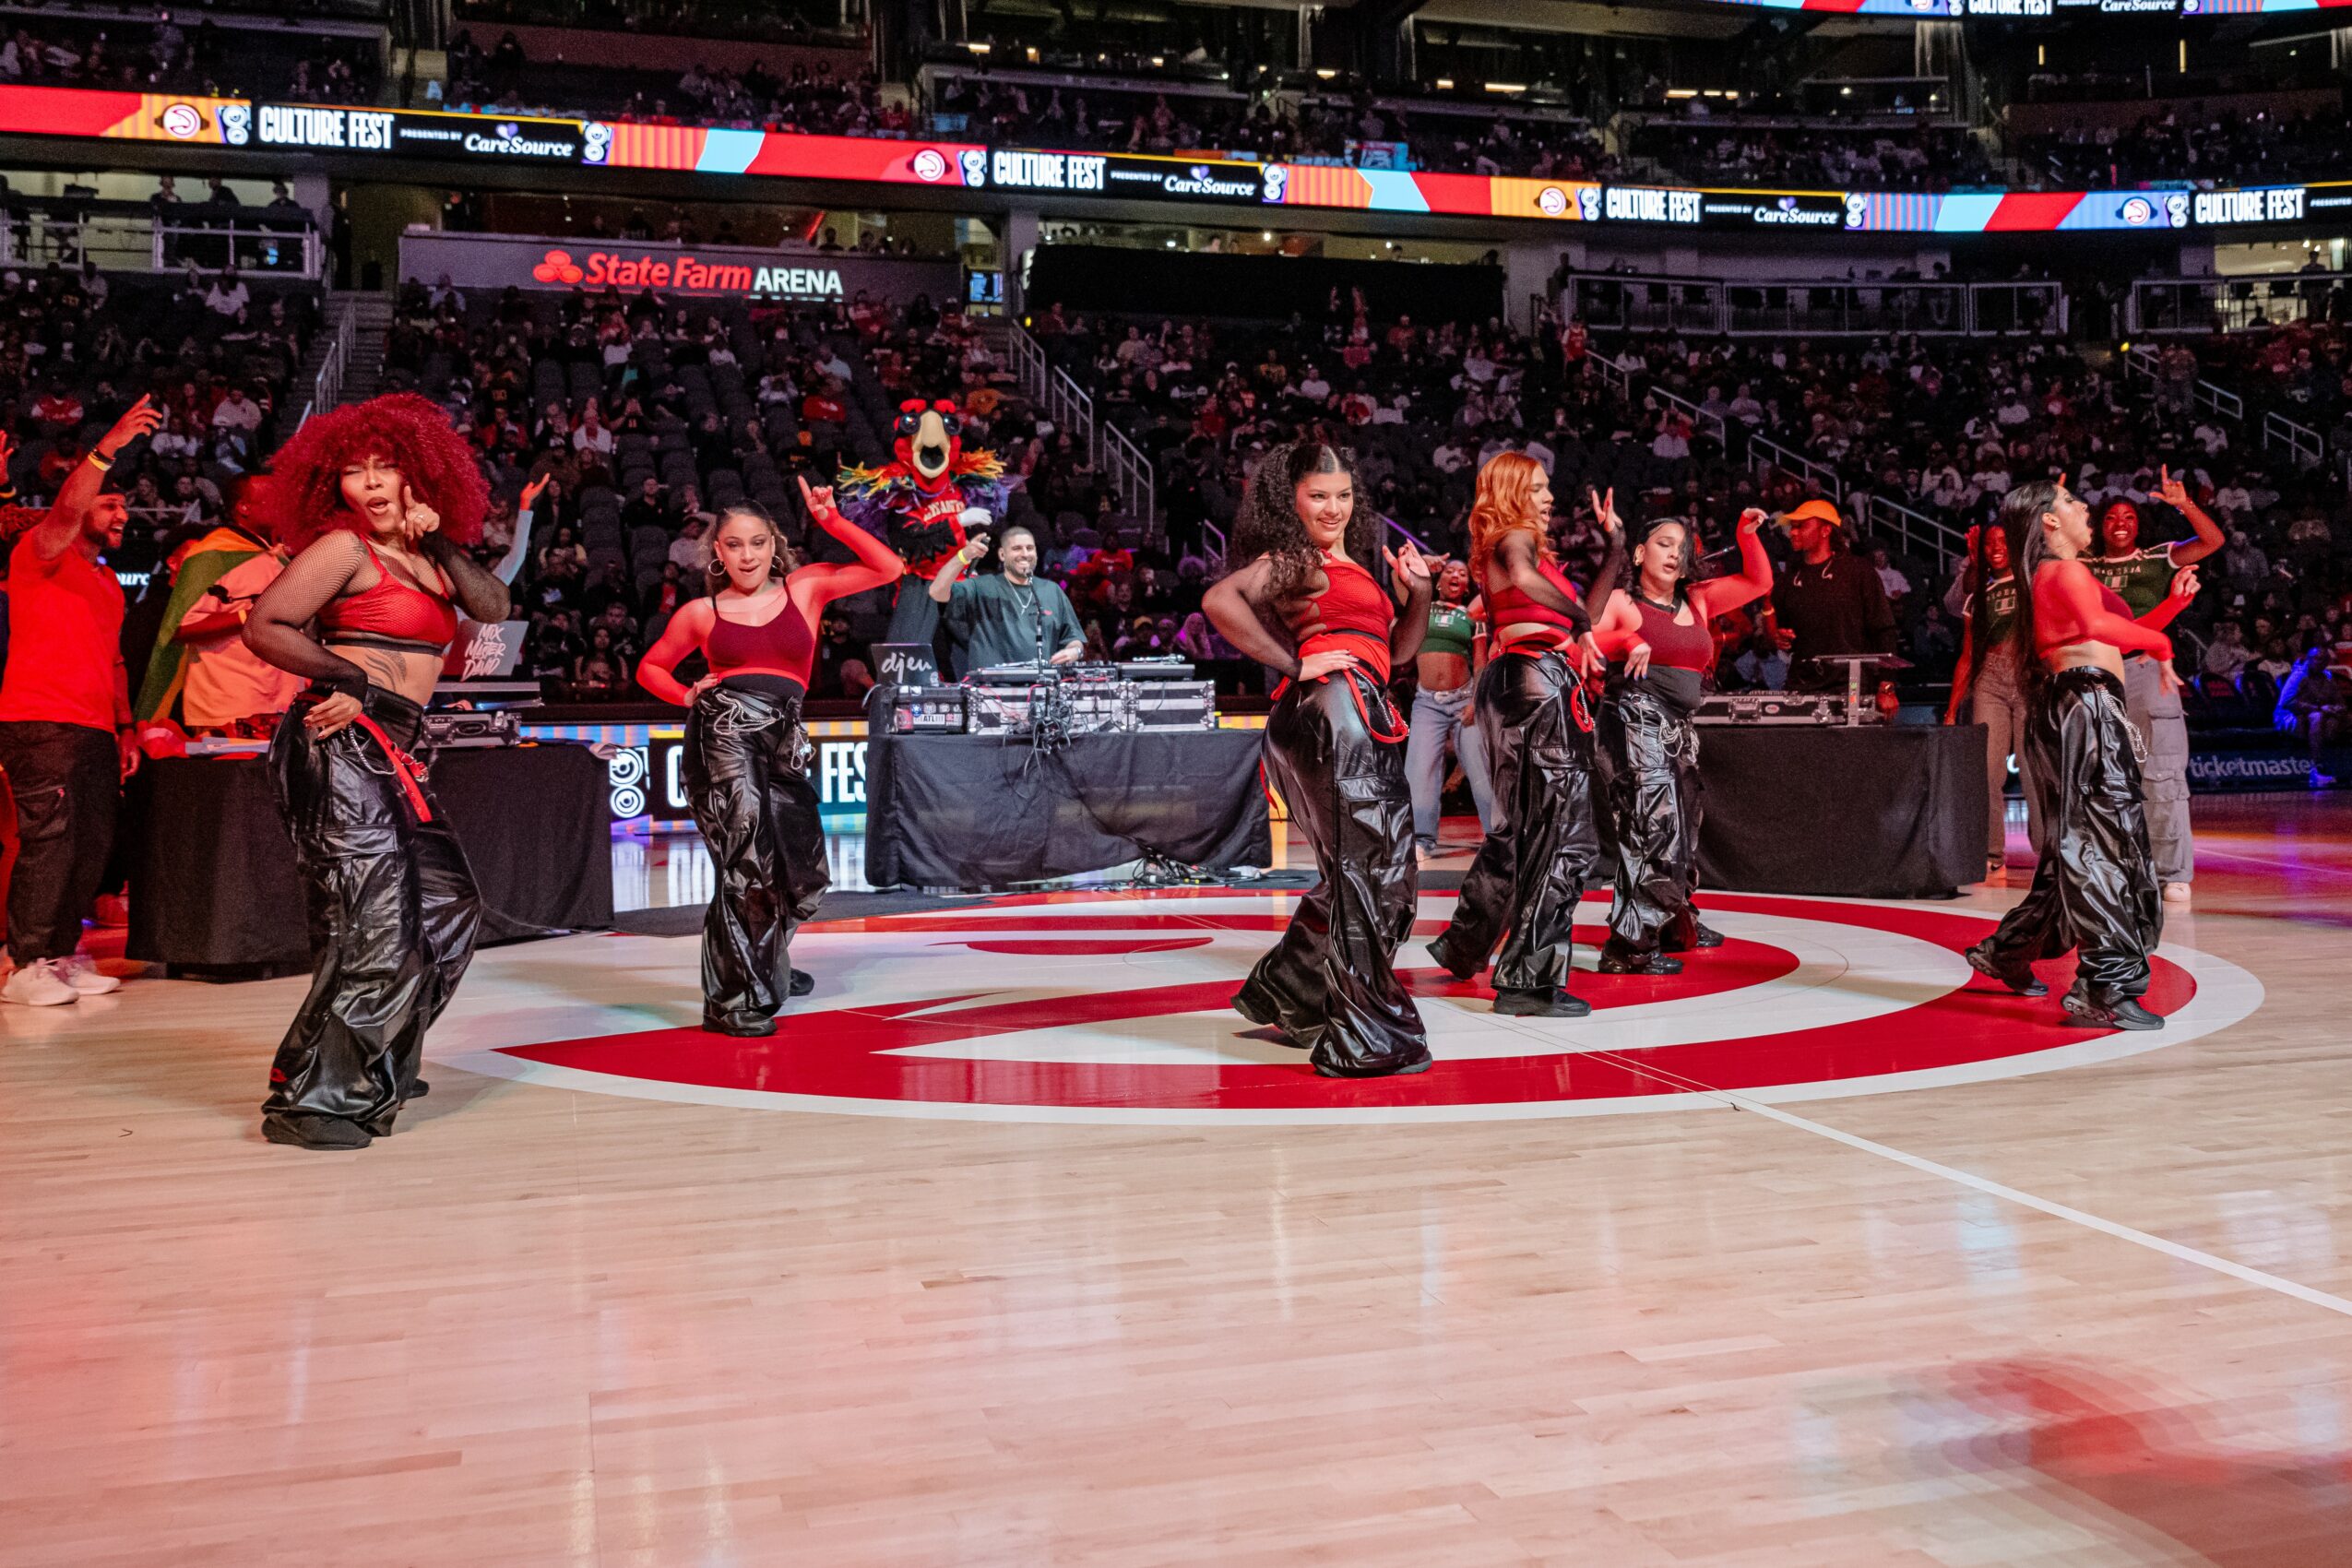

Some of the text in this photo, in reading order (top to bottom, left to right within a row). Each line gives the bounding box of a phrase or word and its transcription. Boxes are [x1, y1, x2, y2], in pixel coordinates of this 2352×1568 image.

[259, 106, 345, 147] CULTURE
[348, 111, 395, 149] FEST
[465, 134, 575, 156] CareSource
[993, 151, 1064, 187] CULTURE
[1067, 155, 1106, 189] FEST
[1164, 175, 1255, 196] CareSource
[1606, 187, 1667, 220] CULTURE
[1669, 191, 1701, 222] FEST
[1753, 207, 1839, 224] CareSource
[2195, 190, 2264, 224] CULTURE
[2267, 188, 2305, 220] FEST
[586, 252, 843, 295] State Farm ARENA
[478, 624, 505, 642] MIX
[821, 742, 868, 802] FES
